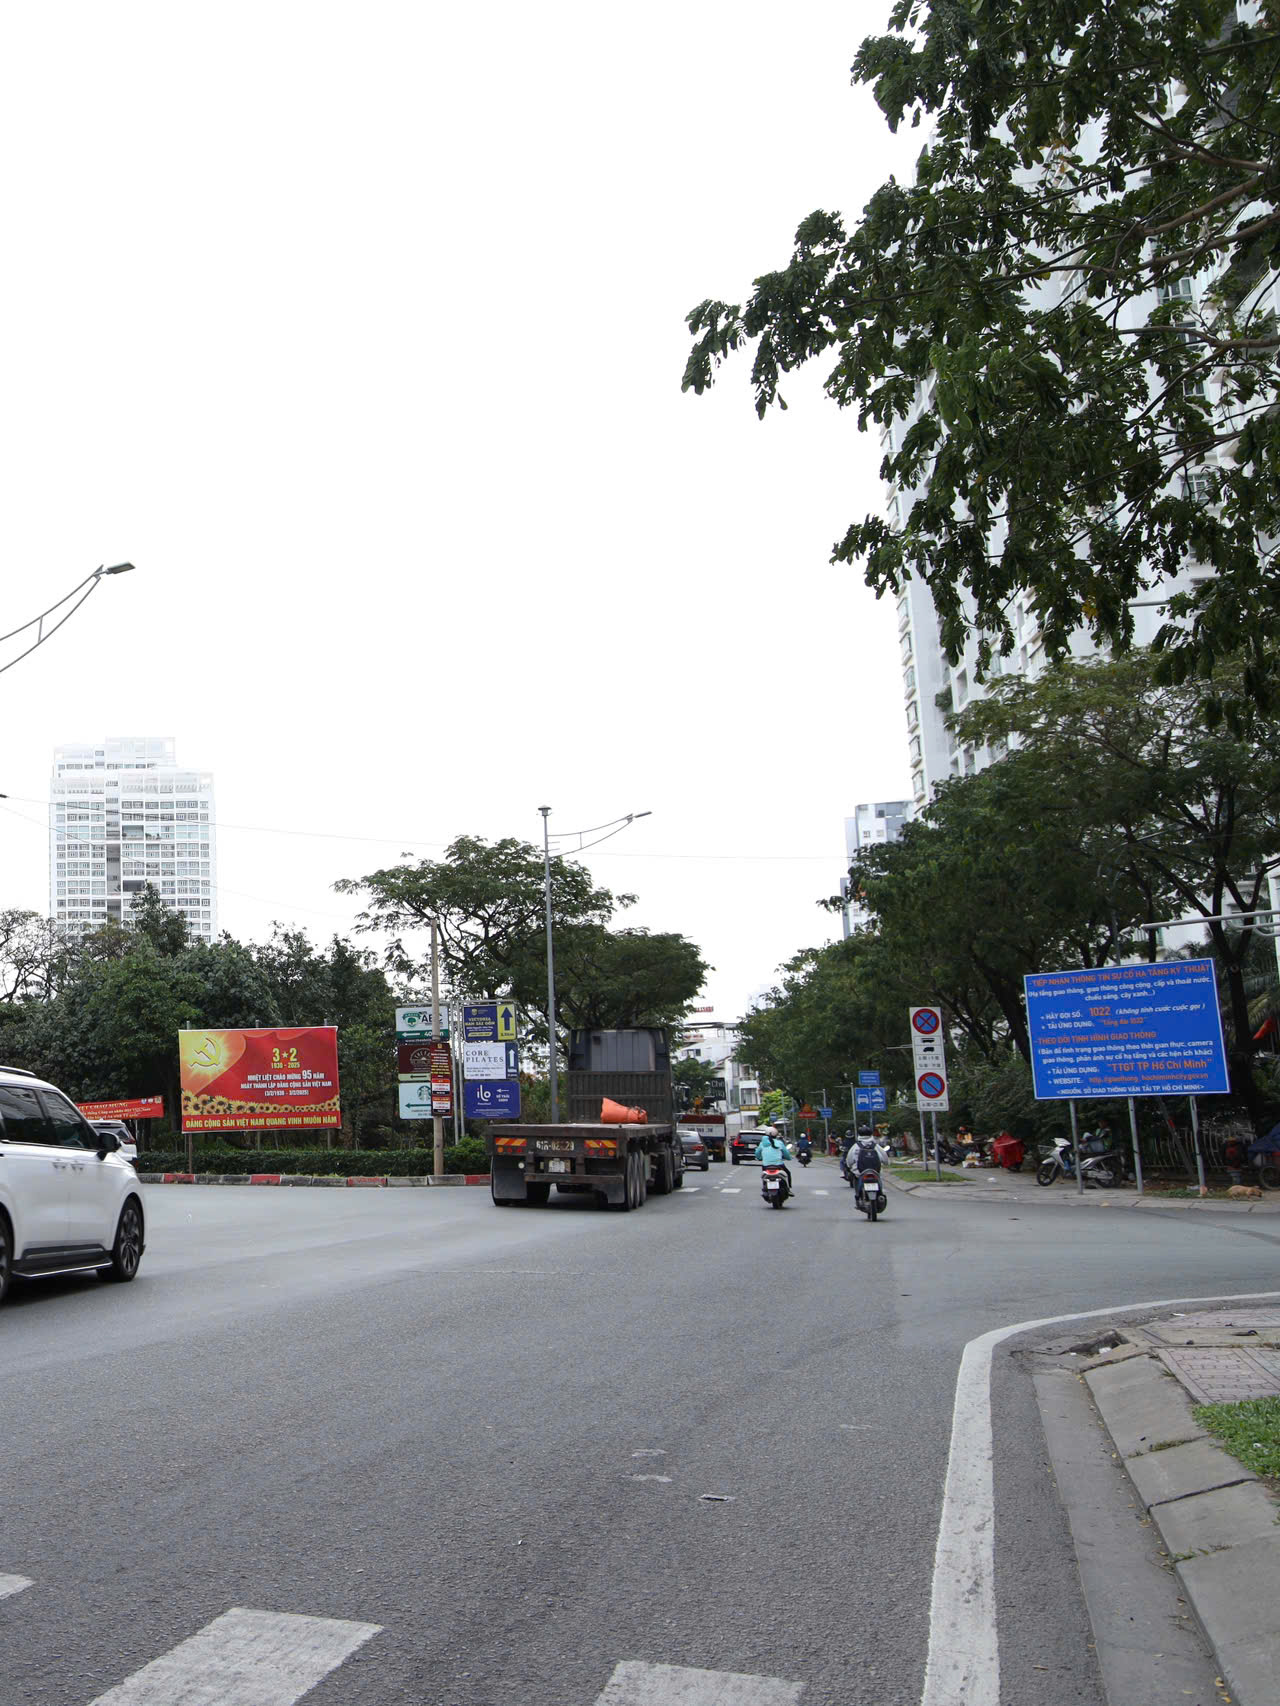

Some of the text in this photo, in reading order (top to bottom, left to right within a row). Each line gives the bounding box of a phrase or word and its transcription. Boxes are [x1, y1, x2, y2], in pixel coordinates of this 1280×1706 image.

[1089, 1007, 1111, 1016] 1022
[272, 1048, 298, 1062] 3 2
[1137, 1062, 1149, 1070] TP
[302, 1070, 312, 1079] 95
[477, 1085, 491, 1101] ilo
[186, 1117, 203, 1127] ĐẢNG
[204, 1117, 220, 1128] CỘNG
[223, 1116, 235, 1126] SẢN
[236, 1115, 249, 1127] VIỆT
[250, 1118, 264, 1126] NAM
[266, 1117, 286, 1126] QUANG
[288, 1117, 302, 1125] VINH
